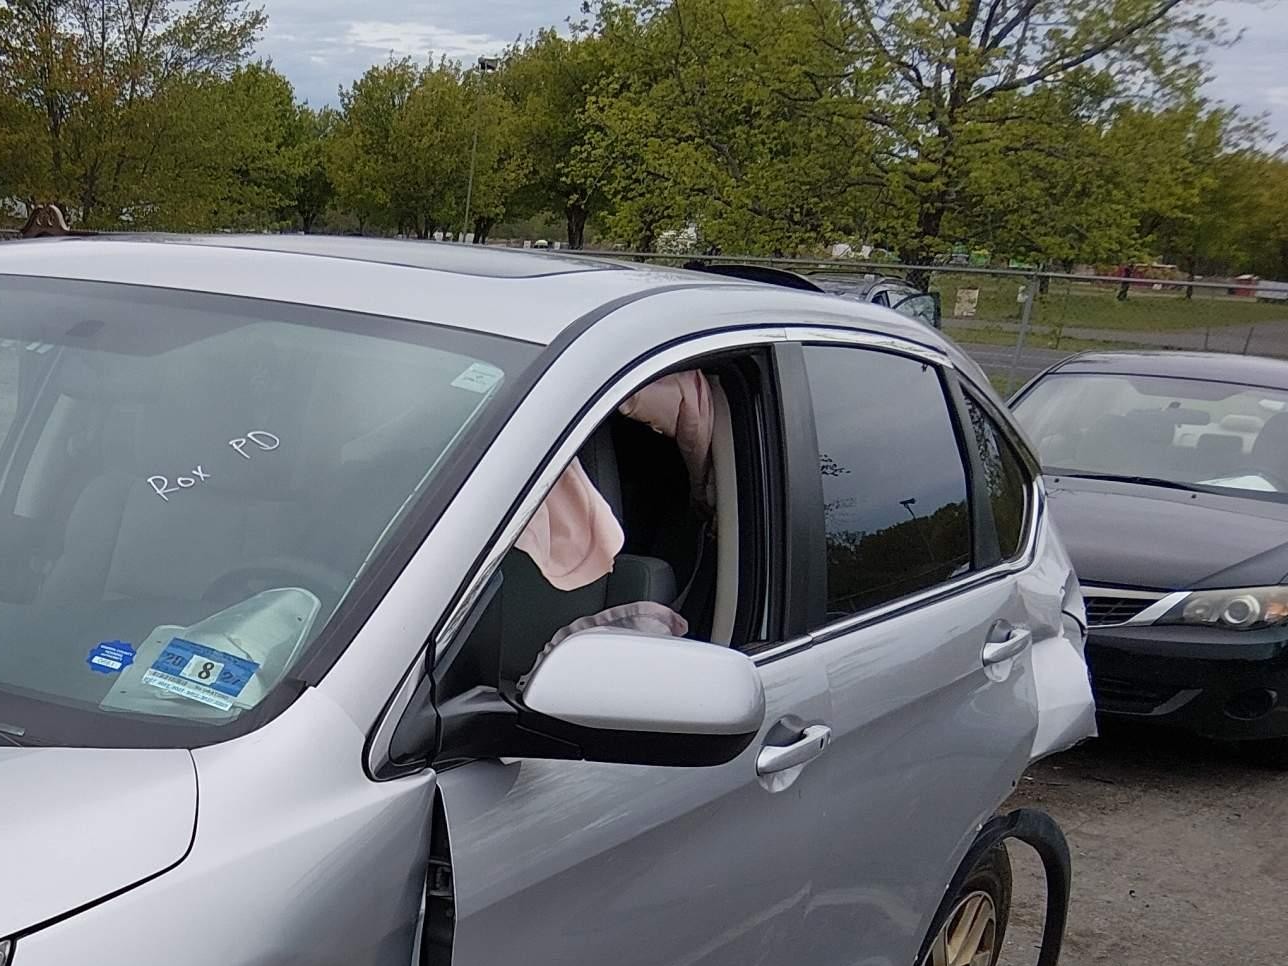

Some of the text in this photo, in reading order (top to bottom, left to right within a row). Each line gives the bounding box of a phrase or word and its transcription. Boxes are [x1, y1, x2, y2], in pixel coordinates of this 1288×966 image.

[147, 430, 280, 501] Rox PD
[198, 662, 215, 680] 8
